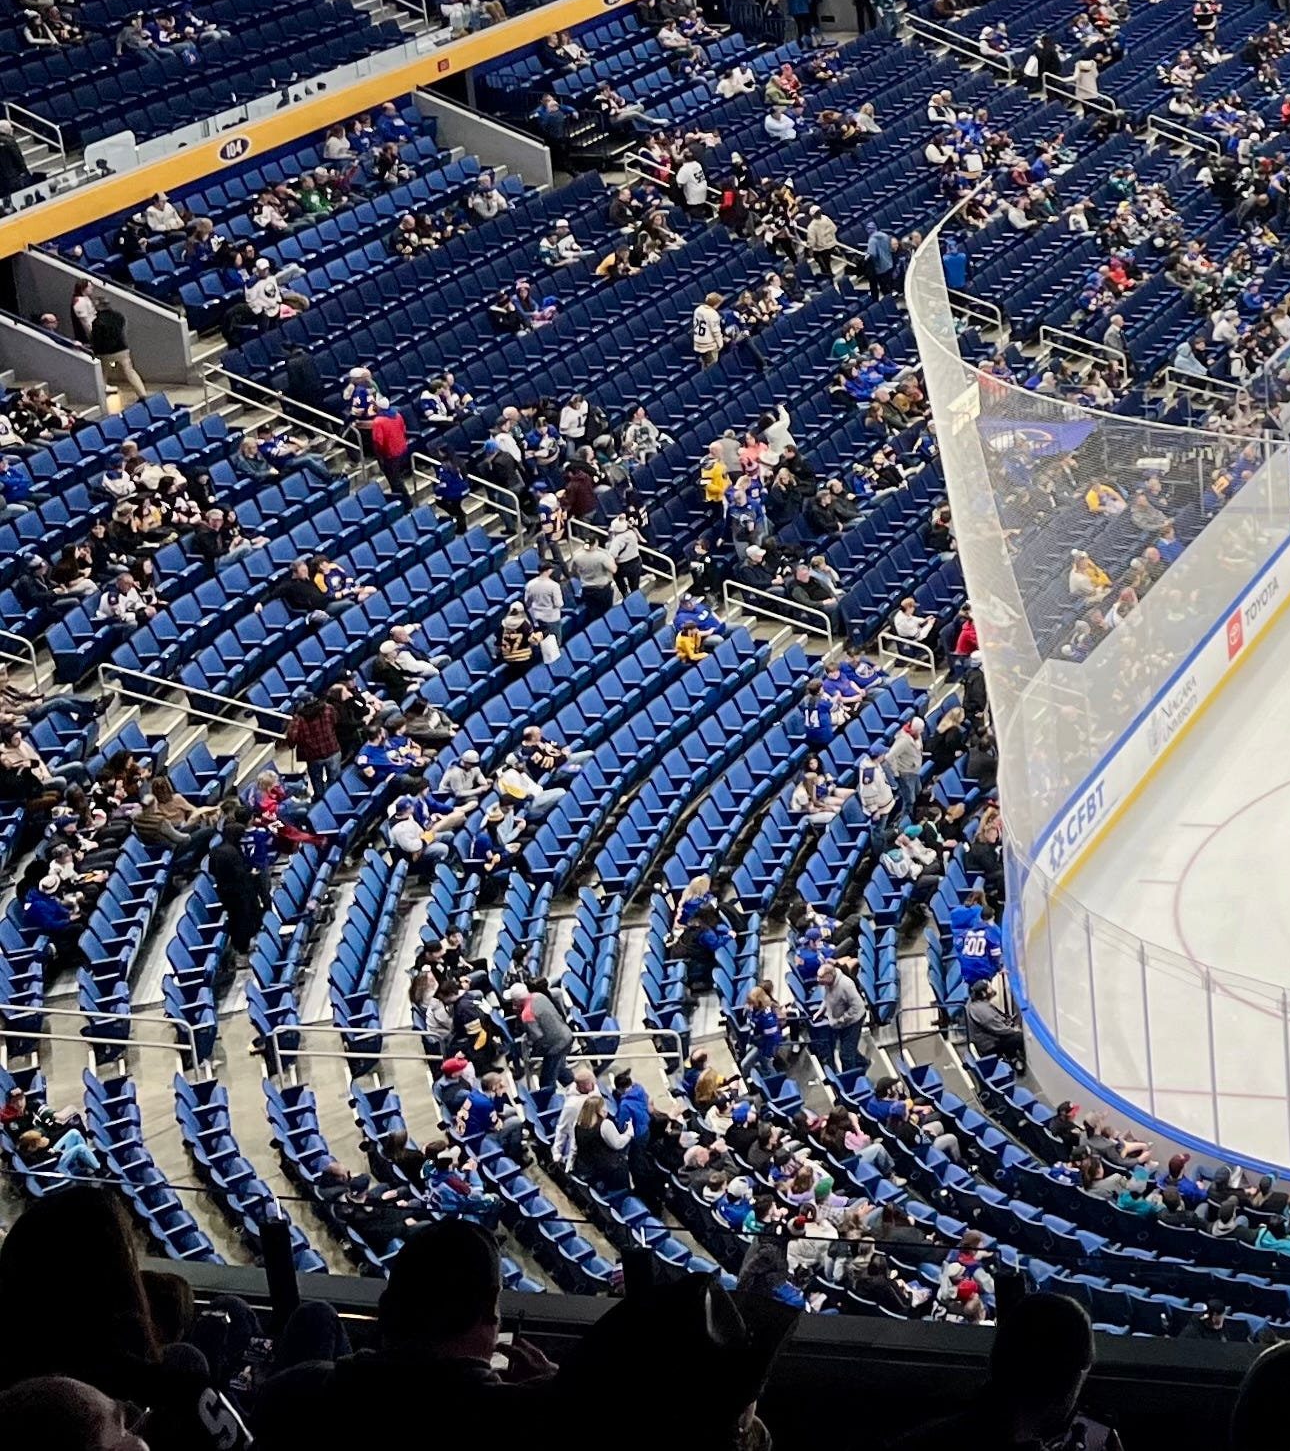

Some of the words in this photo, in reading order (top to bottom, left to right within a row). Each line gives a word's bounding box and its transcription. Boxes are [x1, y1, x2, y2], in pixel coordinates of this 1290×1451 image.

[225, 141, 244, 157] 104
[1244, 577, 1279, 625] TOYOTA
[1066, 780, 1105, 847] CFBT
